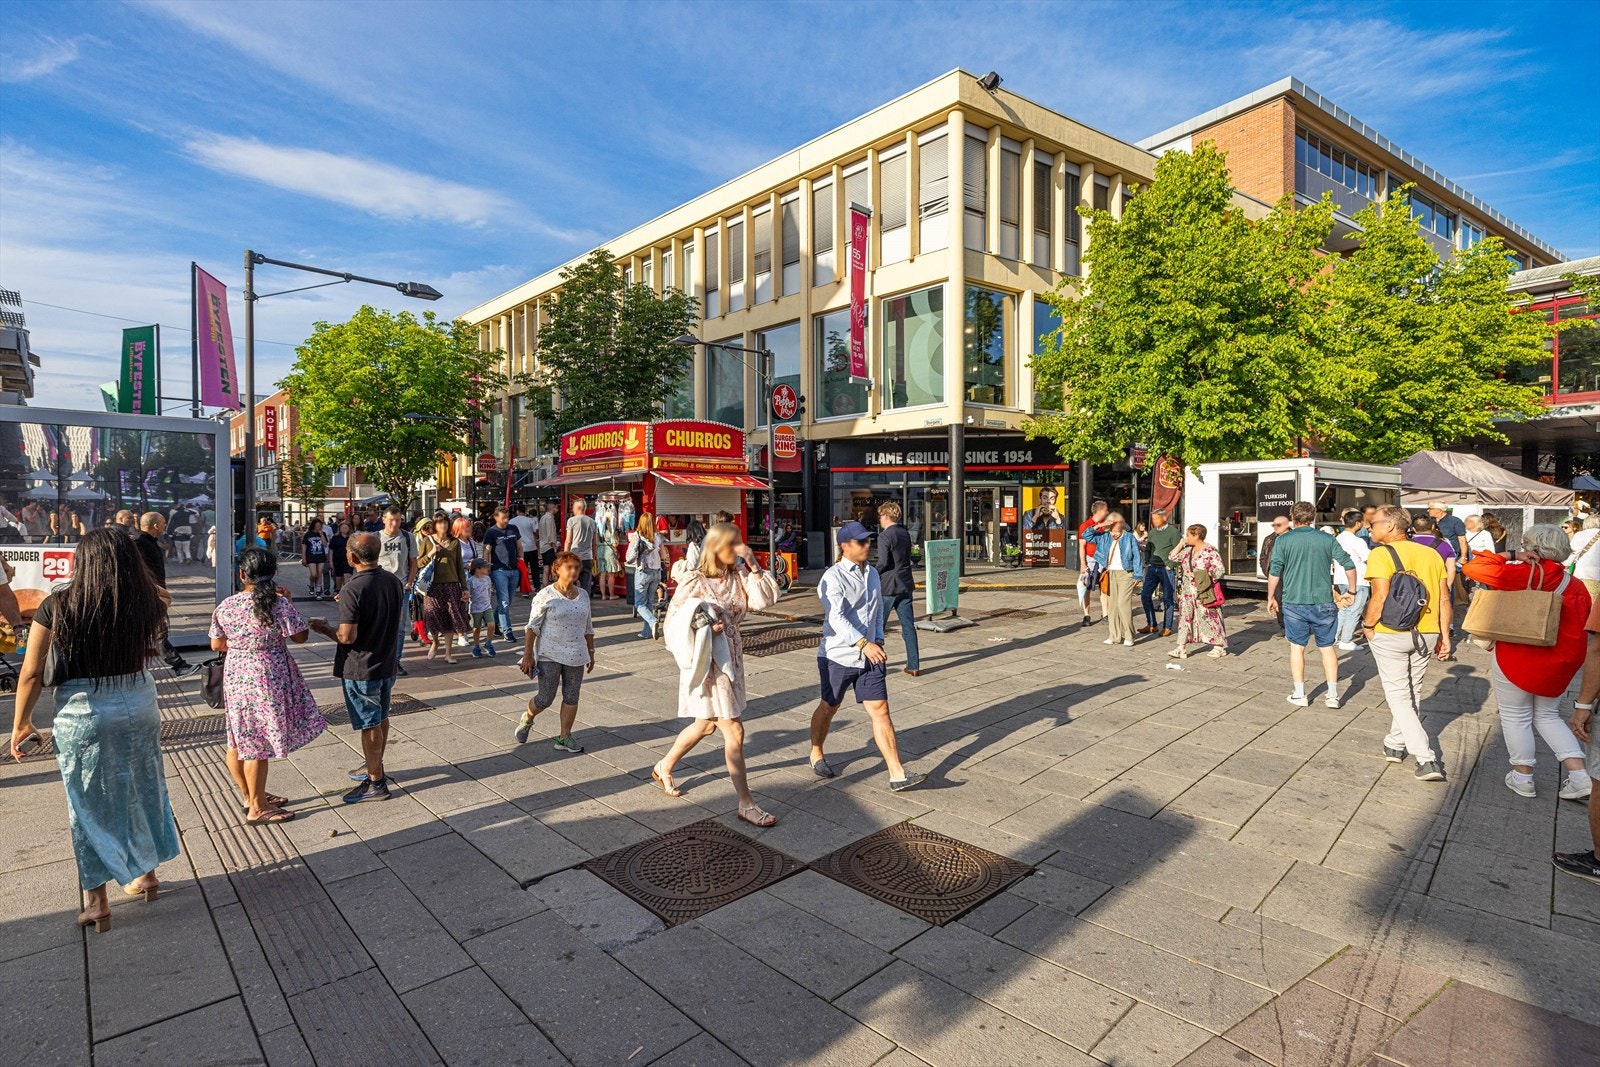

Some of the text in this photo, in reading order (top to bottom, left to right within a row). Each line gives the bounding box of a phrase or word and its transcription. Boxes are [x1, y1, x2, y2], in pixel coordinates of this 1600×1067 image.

[210, 293, 232, 395] BYFESTEN
[266, 409, 275, 448] HOTEL
[580, 430, 624, 451] CHURROS
[666, 429, 732, 450] CHURROS
[775, 441, 796, 451] KING
[865, 450, 1033, 465] FLAME GRILLIN SINCE 1954
[1025, 541, 1062, 549] middagen
[1025, 548, 1049, 557] konge
[44, 557, 70, 576] 29
